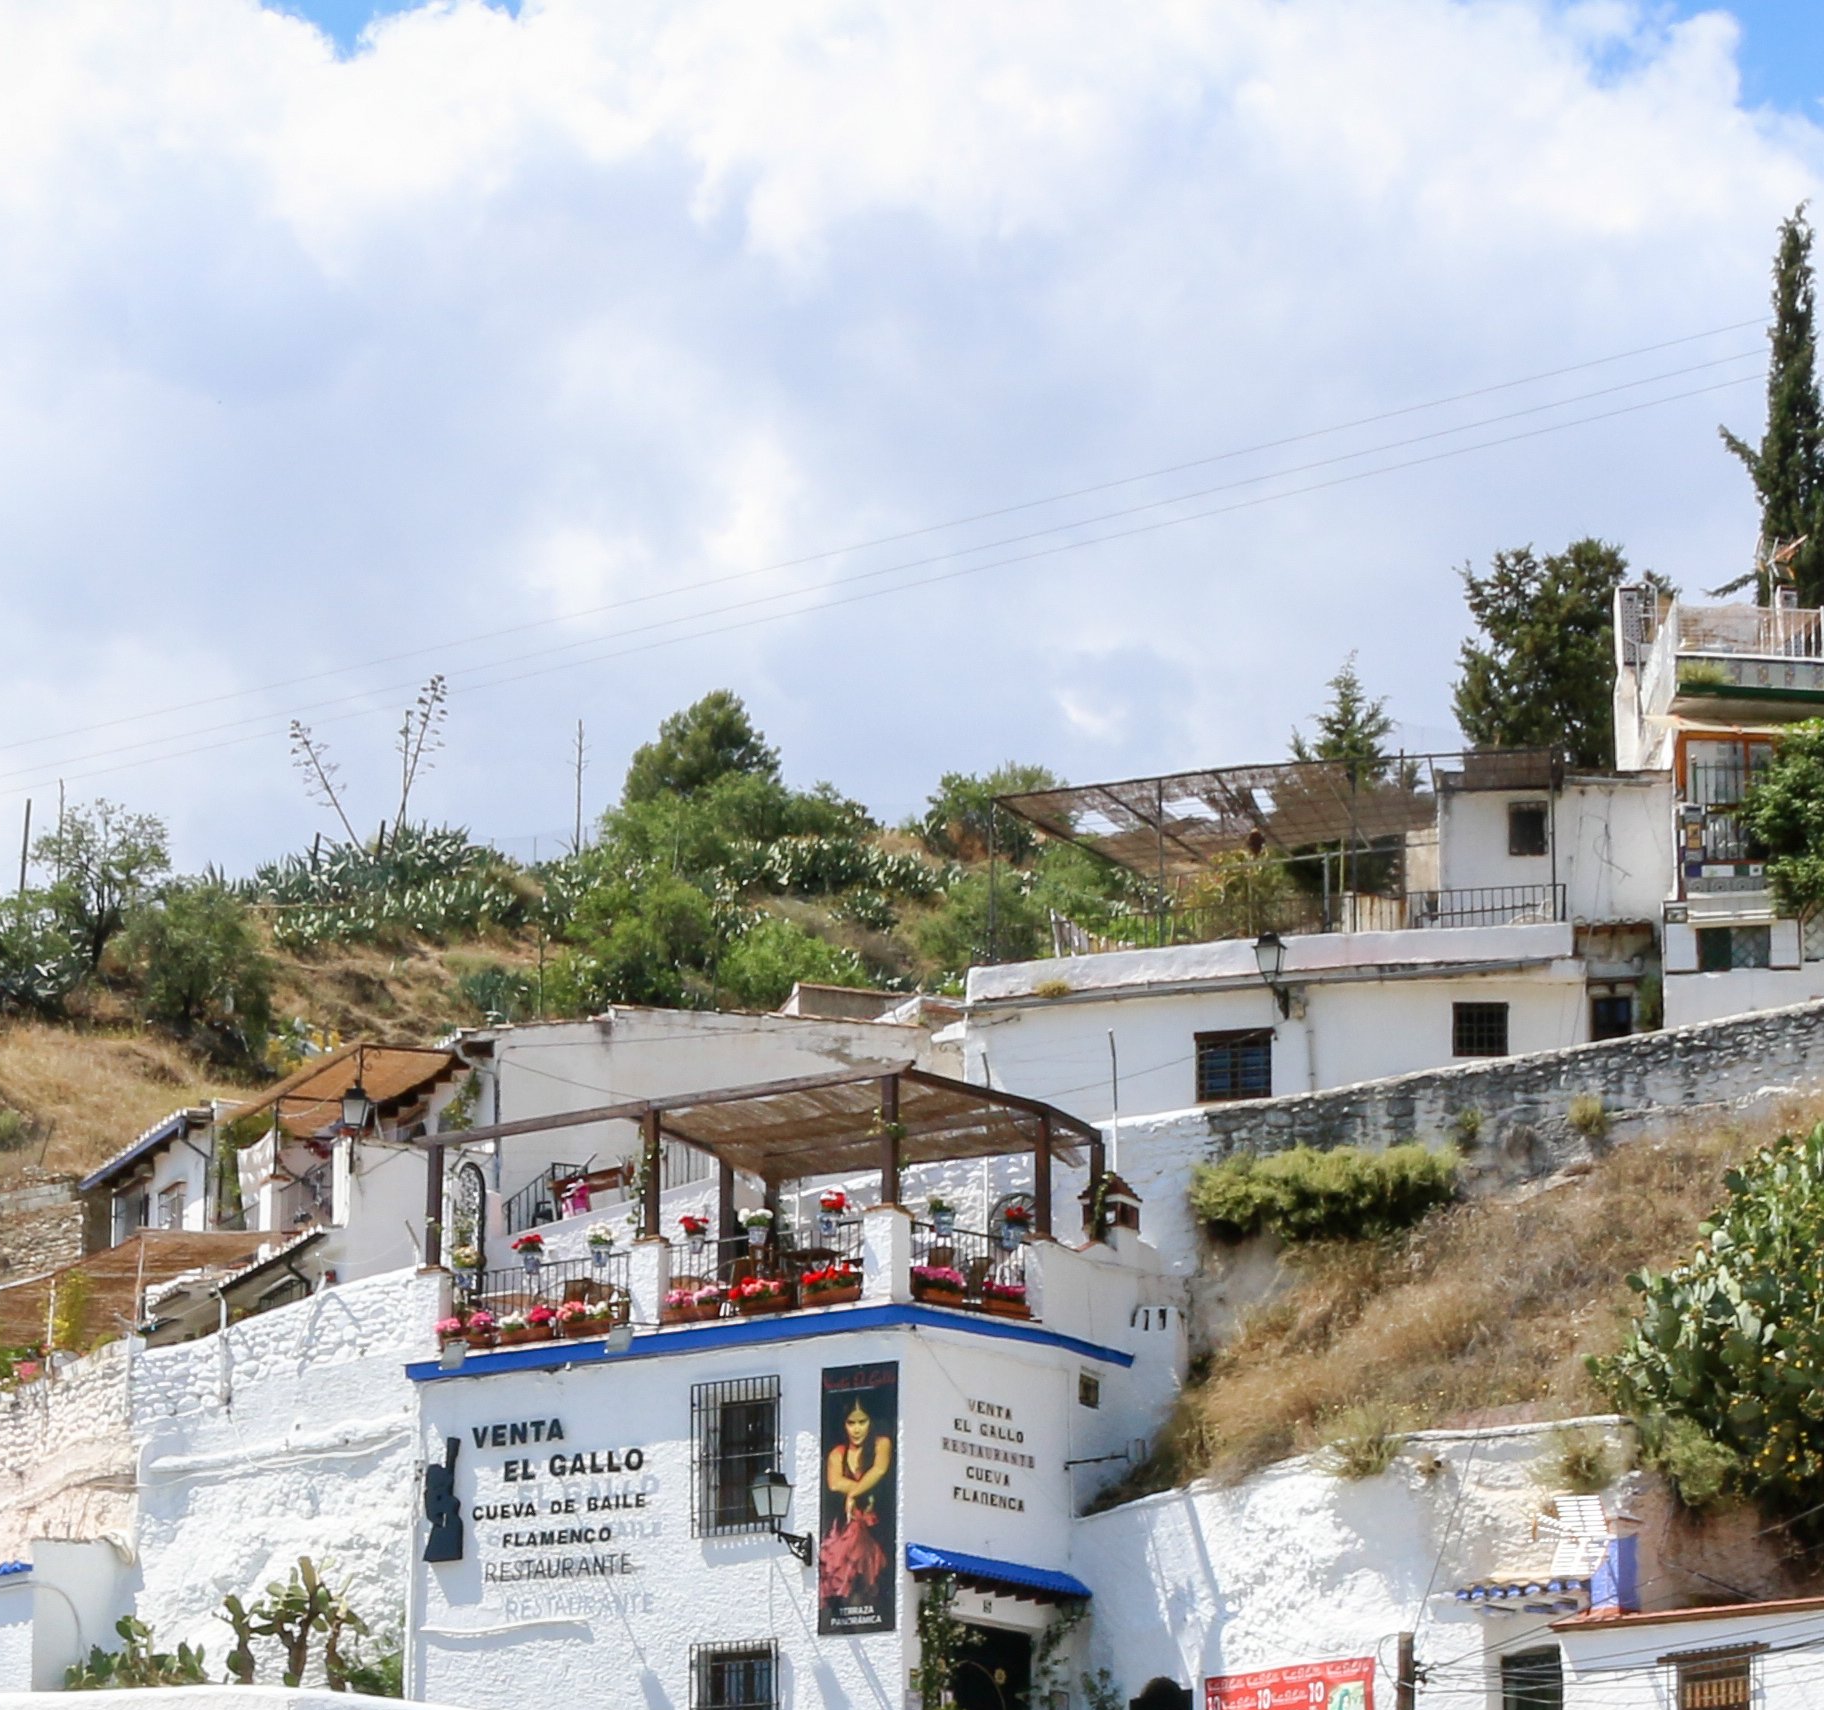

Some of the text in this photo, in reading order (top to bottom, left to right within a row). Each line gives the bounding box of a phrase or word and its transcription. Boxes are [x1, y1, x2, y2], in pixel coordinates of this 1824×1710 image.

[967, 1398, 1013, 1421] VENTA
[472, 1418, 565, 1449] VENTA
[954, 1418, 1024, 1444] EL GALLO
[503, 1448, 644, 1483] EL GALLO
[942, 1437, 1035, 1469] RESTAURANTE
[966, 1466, 1010, 1487] CUEVA
[472, 1492, 647, 1522] CUEVA DE BAILE
[953, 1486, 1025, 1512] FLAMENCA
[502, 1527, 612, 1548] FLAMENCO
[484, 1553, 633, 1584] RESTAURANTE
[839, 1605, 874, 1616] TERRAZA
[1257, 1688, 1271, 1710] 10
[1308, 1681, 1324, 1703] 10
